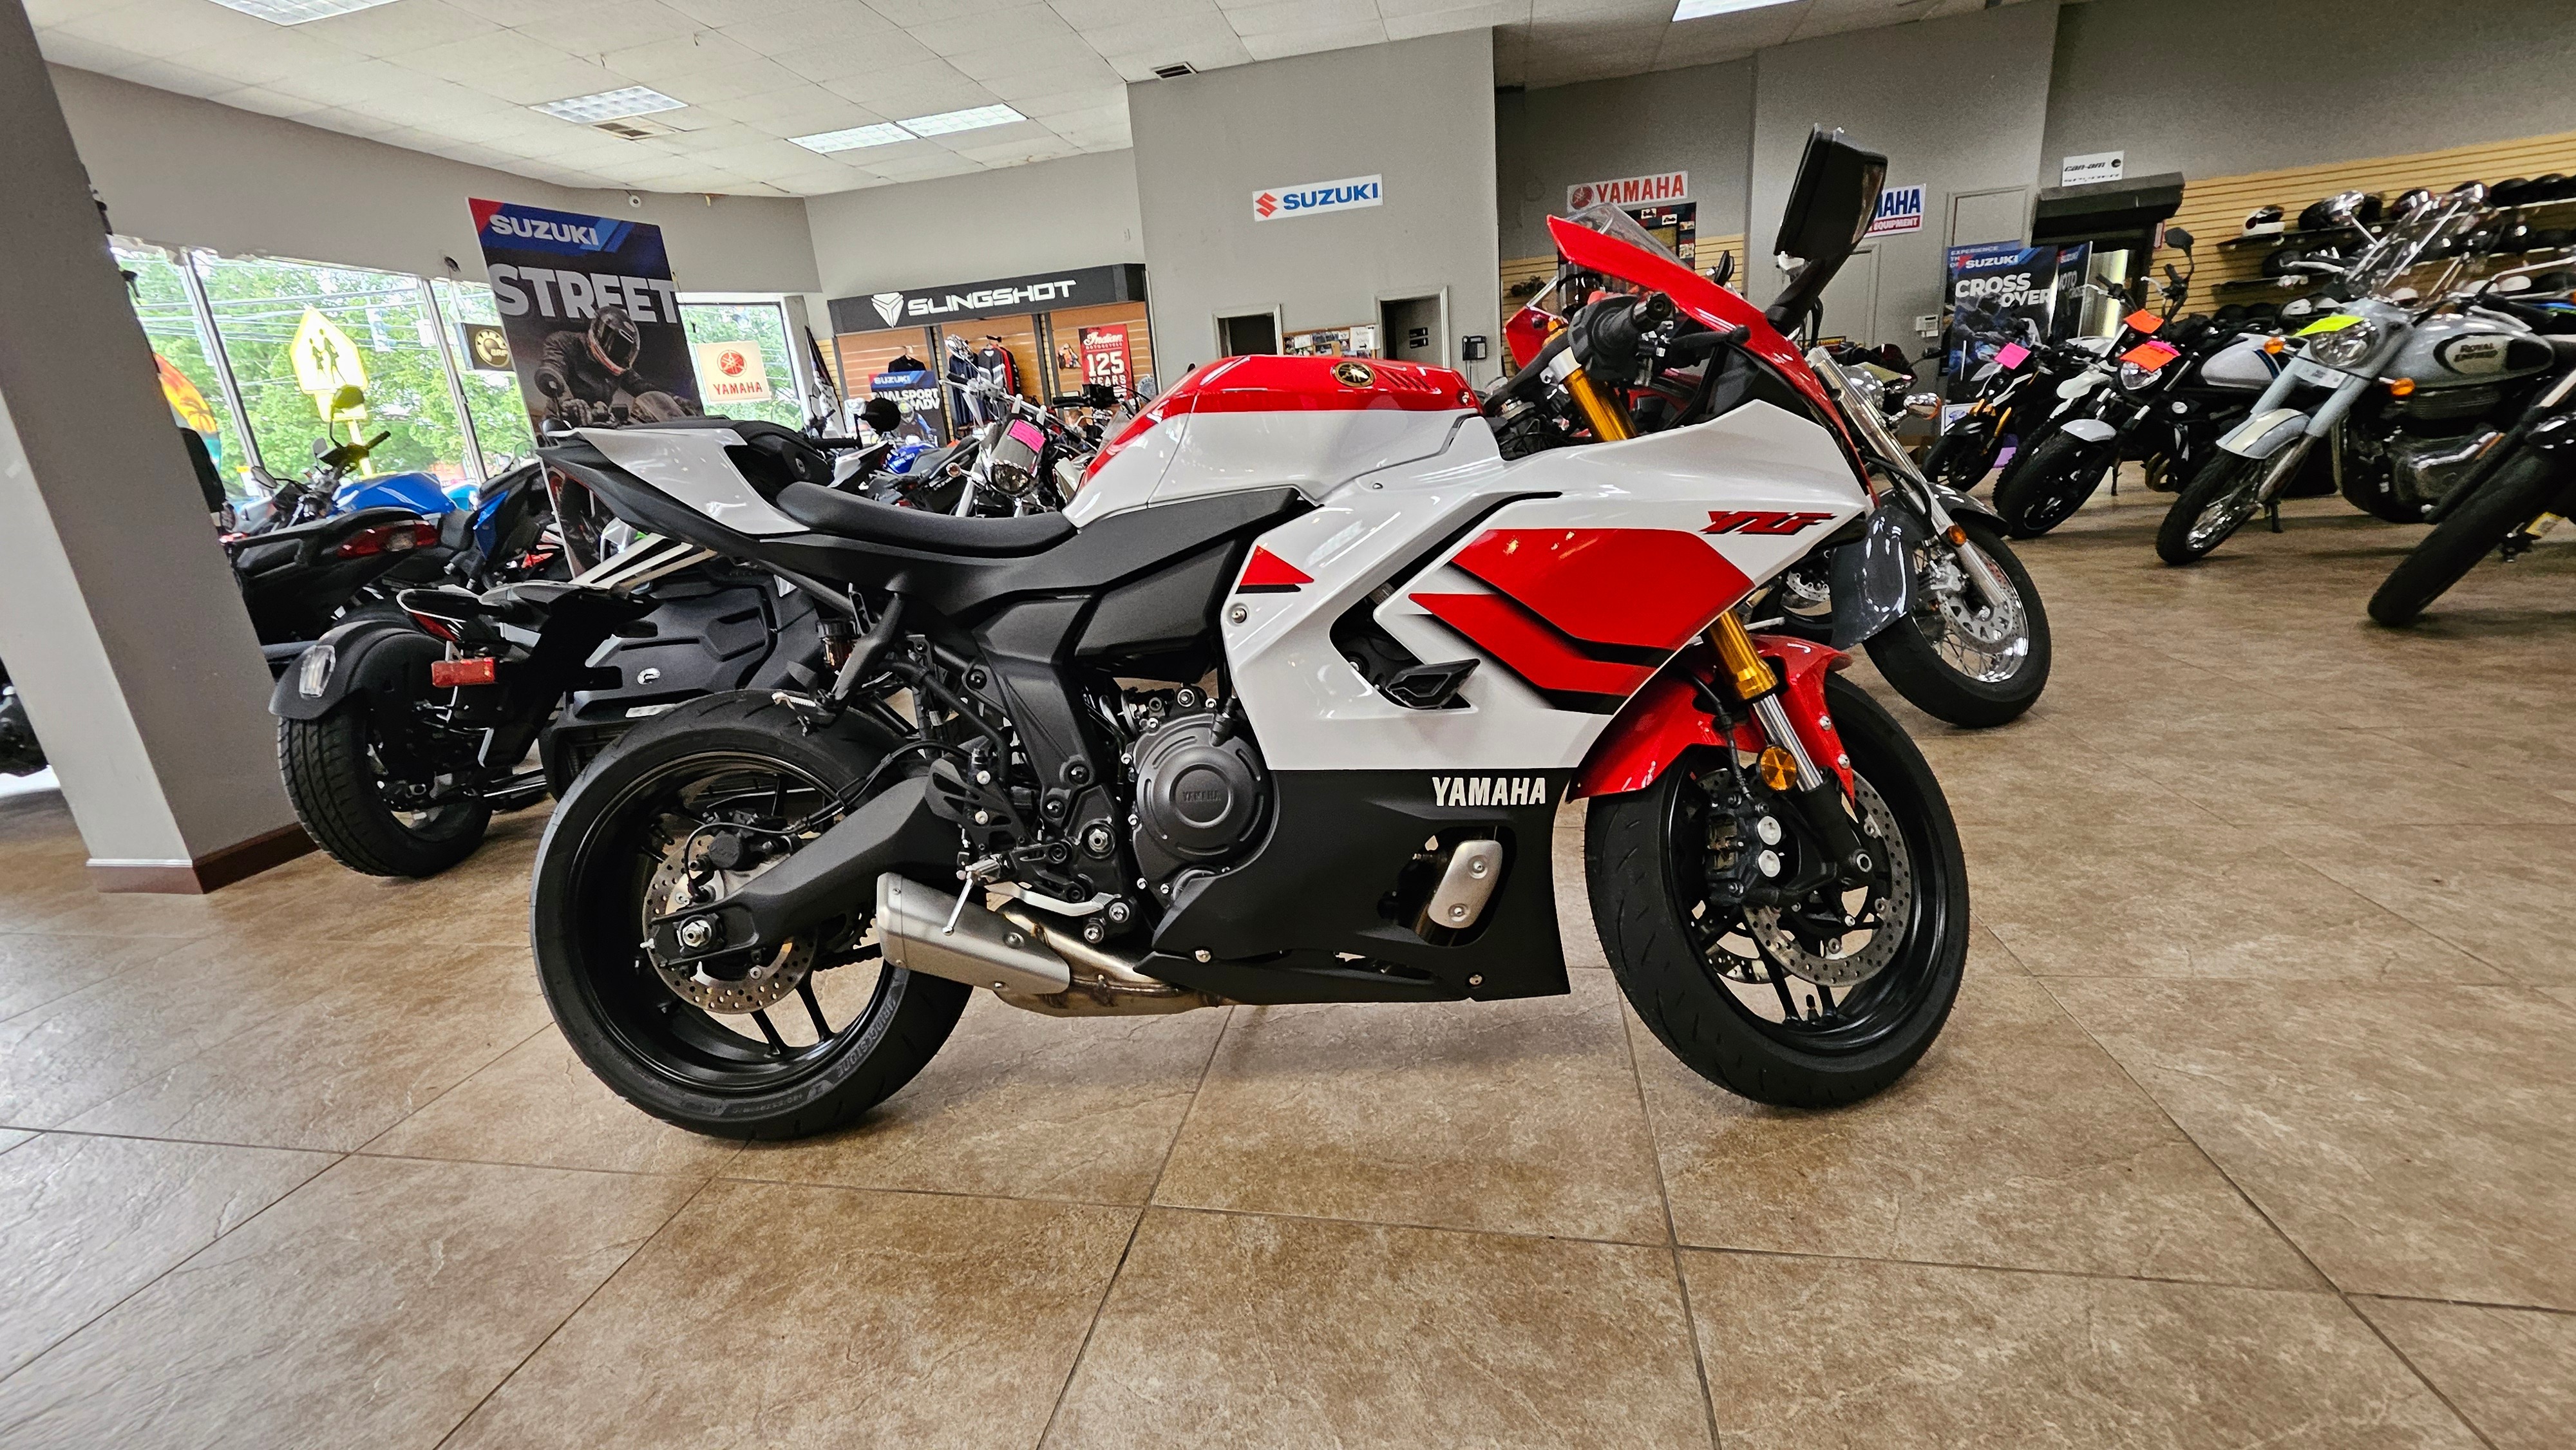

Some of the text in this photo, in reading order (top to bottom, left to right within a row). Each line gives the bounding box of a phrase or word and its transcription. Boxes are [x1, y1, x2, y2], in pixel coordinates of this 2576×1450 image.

[1283, 182, 1379, 211] SUZUKI
[1596, 174, 1685, 203] YAMAHA
[1876, 189, 1921, 218] AHA
[489, 214, 600, 246] SUZUKI
[1873, 218, 1918, 231] EQUIPMENT
[1965, 255, 2019, 269] SUZUKI
[488, 263, 679, 323] STREET
[1955, 272, 2031, 297] CROSS
[908, 279, 1077, 317] SLINGSHOT
[2000, 288, 2051, 308] OVER
[1083, 332, 1123, 346] Indian
[1087, 351, 1125, 377] 125
[713, 381, 763, 395] YAMAHA
[873, 375, 913, 384] SUZUKI
[1089, 375, 1126, 387] YEARS
[1432, 777, 1546, 807] YAMAHA
